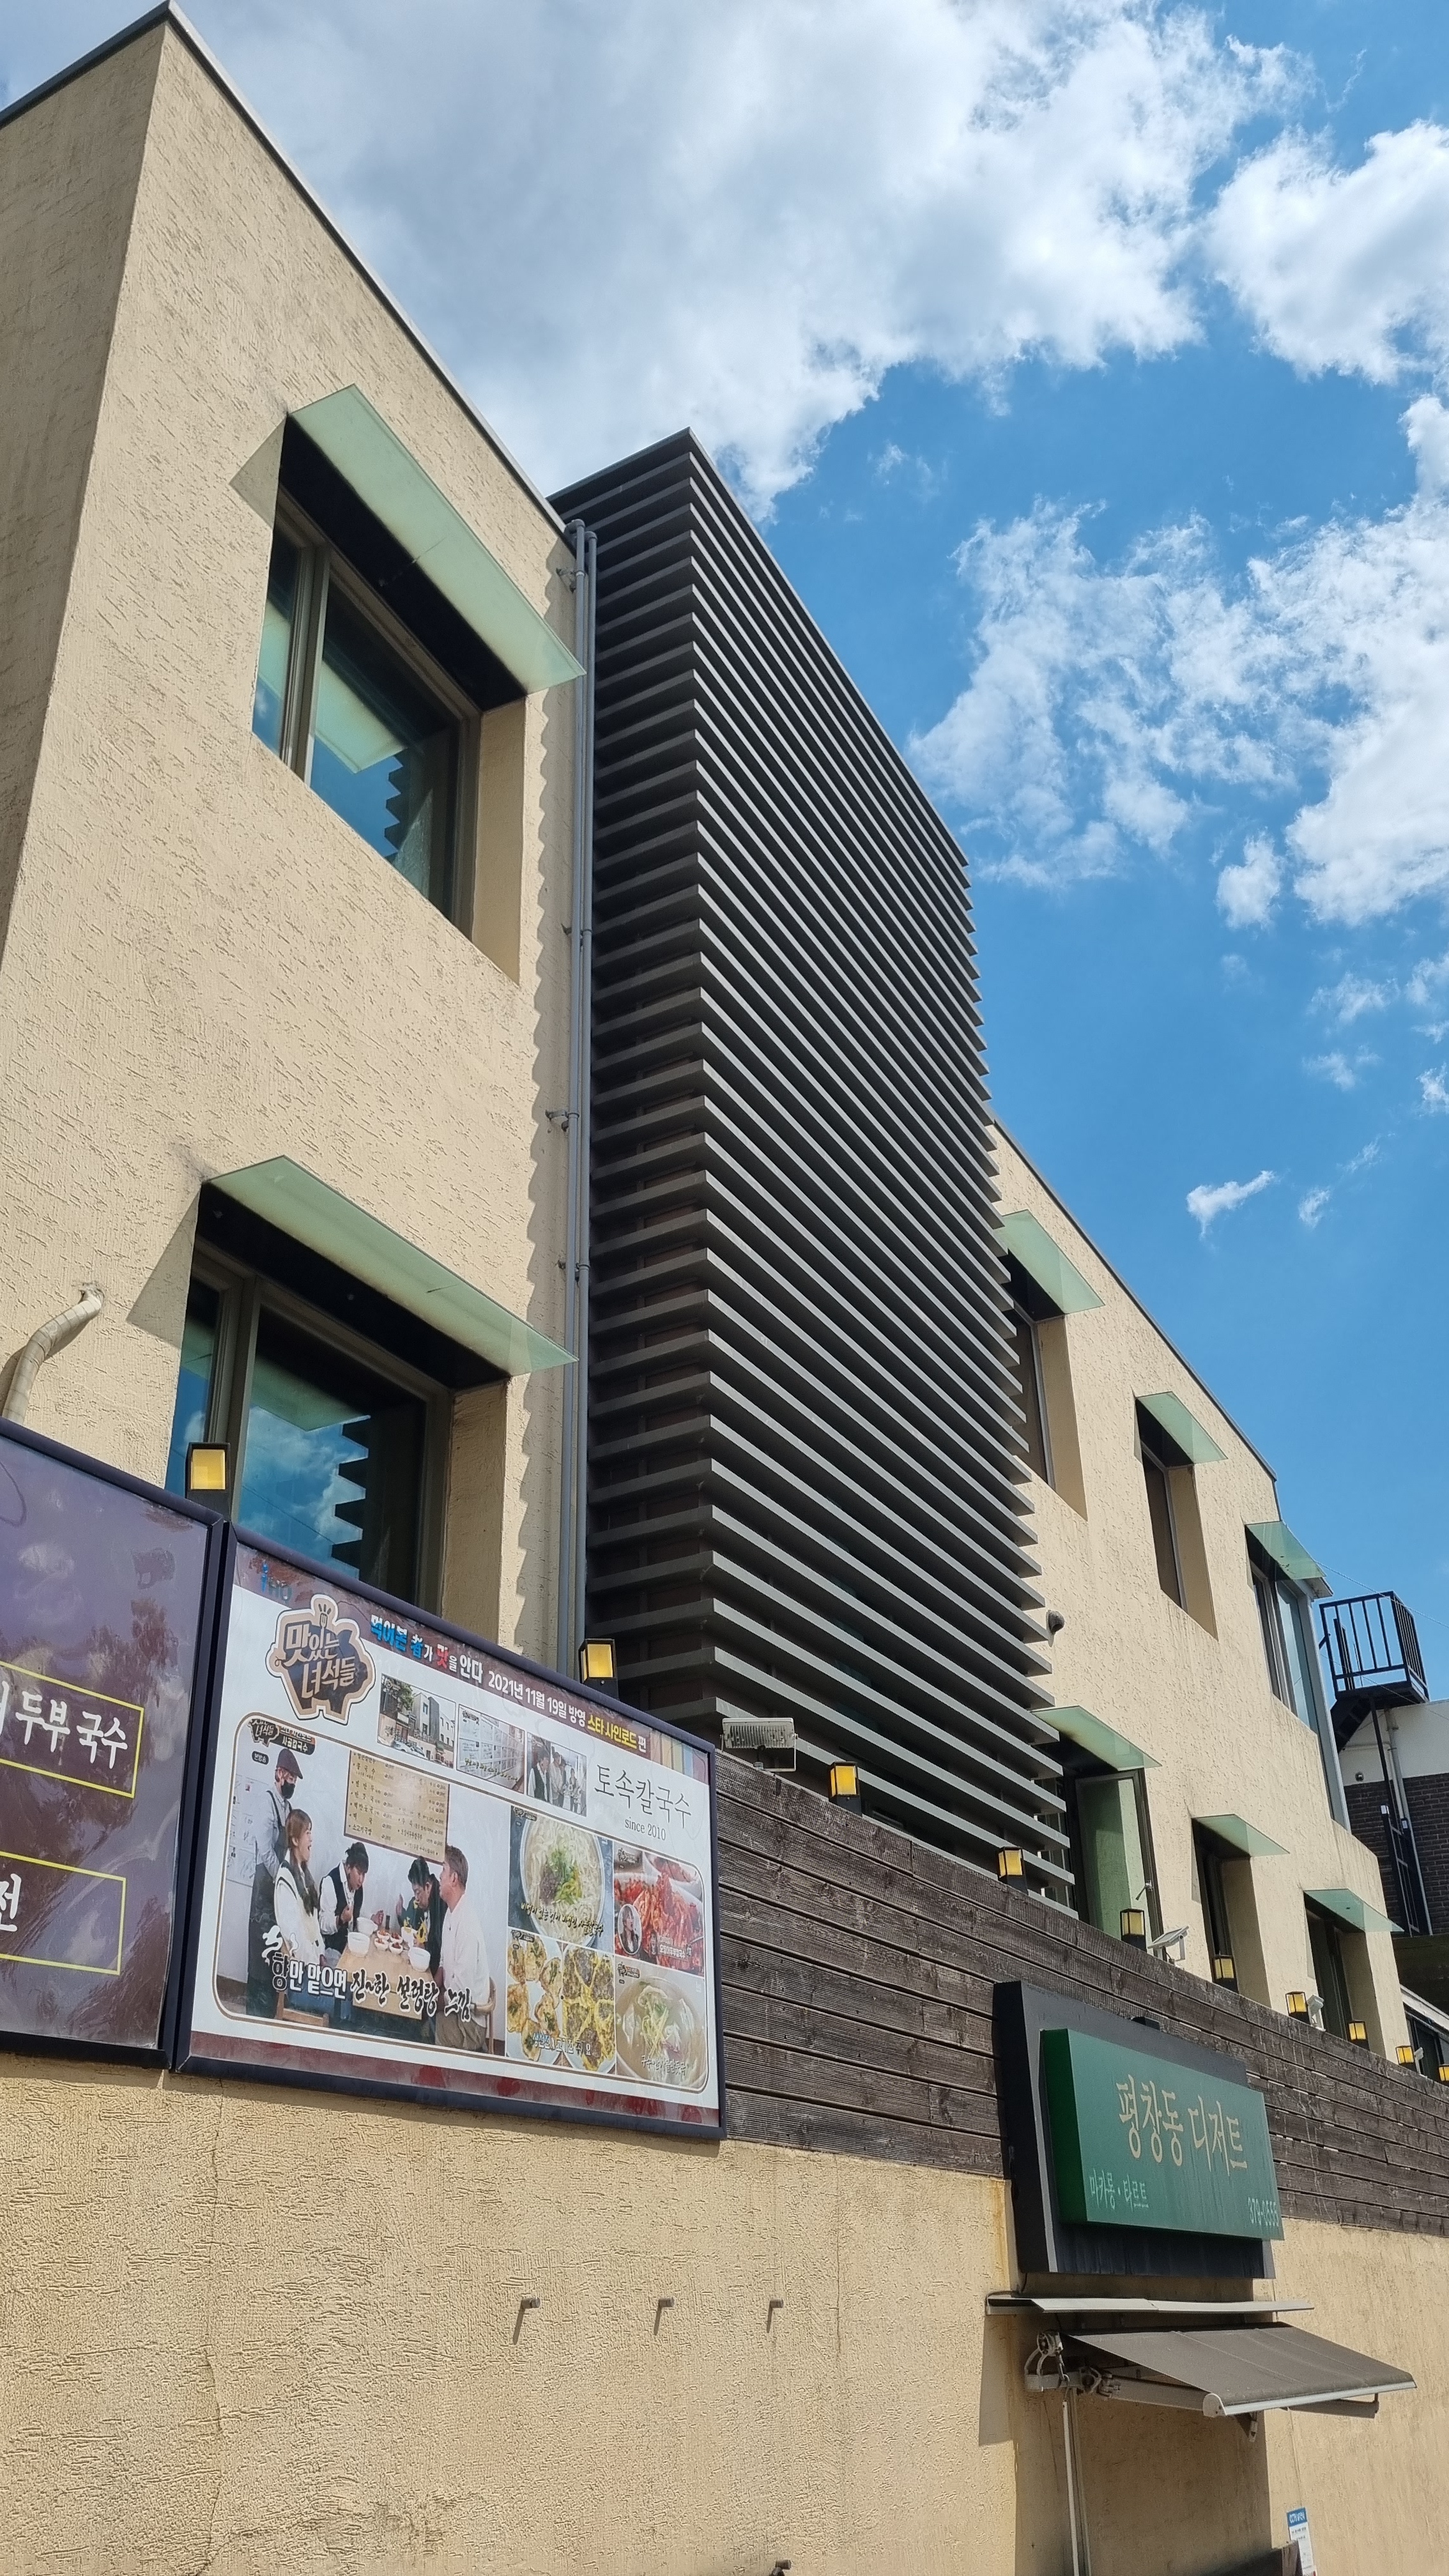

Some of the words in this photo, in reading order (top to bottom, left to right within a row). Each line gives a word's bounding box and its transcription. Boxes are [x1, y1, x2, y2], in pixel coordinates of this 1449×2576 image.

[284, 1623, 339, 1666] 맛있는
[302, 1657, 356, 1699] 녀석들
[371, 1614, 408, 1652] 먹어본
[459, 1655, 482, 1683] 안다
[488, 1670, 523, 1700] 2021년
[525, 1687, 545, 1710] 11월
[547, 1697, 567, 1719] 19일
[569, 1705, 586, 1728] 방영
[587, 1713, 604, 1735] 스타
[604, 1721, 637, 1749] 사인로드
[638, 1735, 647, 1753] 편
[15, 1691, 70, 1752] 두부
[76, 1711, 128, 1769] 국수
[594, 1763, 692, 1829] 토속칼국수
[624, 1817, 645, 1834] since
[647, 1823, 666, 1841] 2010
[307, 1963, 347, 2000] 맡으면
[397, 1974, 439, 2016] 설렁탕
[445, 1988, 471, 2022] 느낌
[1116, 2073, 1183, 2168] 평창동
[1188, 2094, 1248, 2176] 디저트
[1090, 2168, 1117, 2211] 마카롱
